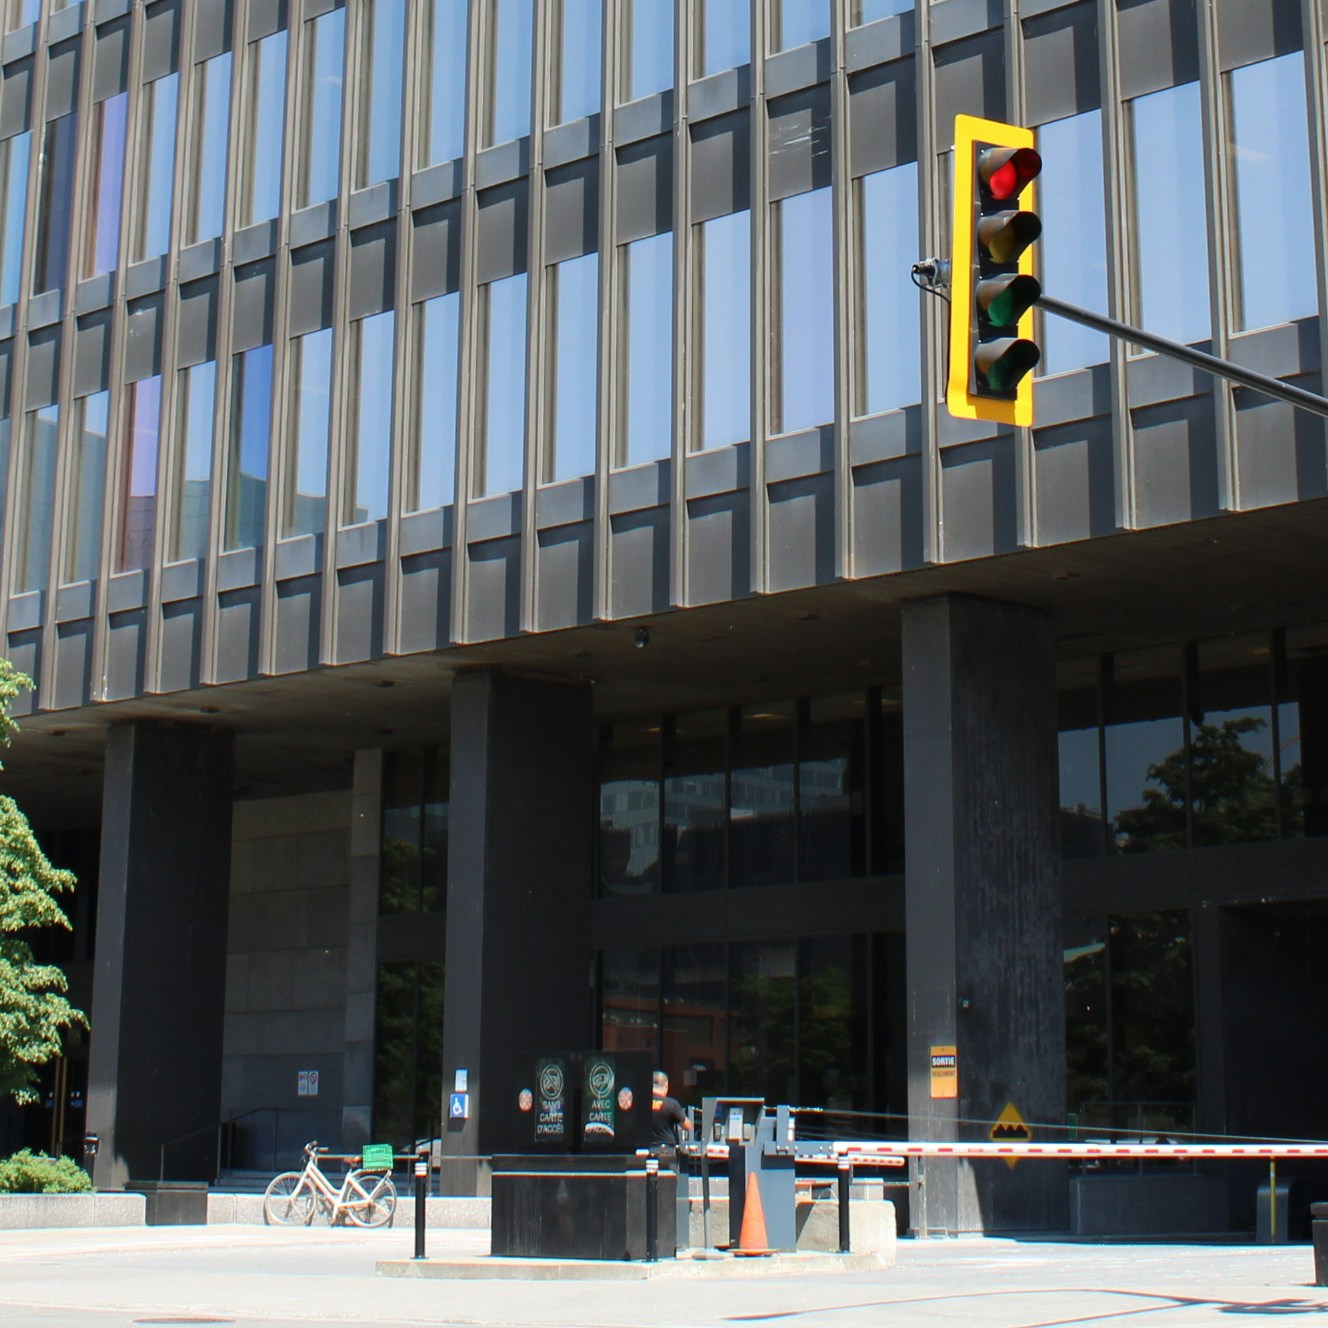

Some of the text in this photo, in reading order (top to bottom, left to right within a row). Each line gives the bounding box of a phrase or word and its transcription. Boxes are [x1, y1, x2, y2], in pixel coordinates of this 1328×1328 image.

[932, 1056, 955, 1066] SORTIE
[592, 1099, 611, 1109] AVEC
[539, 1112, 563, 1123] CARTE
[589, 1112, 612, 1122] CARTE
